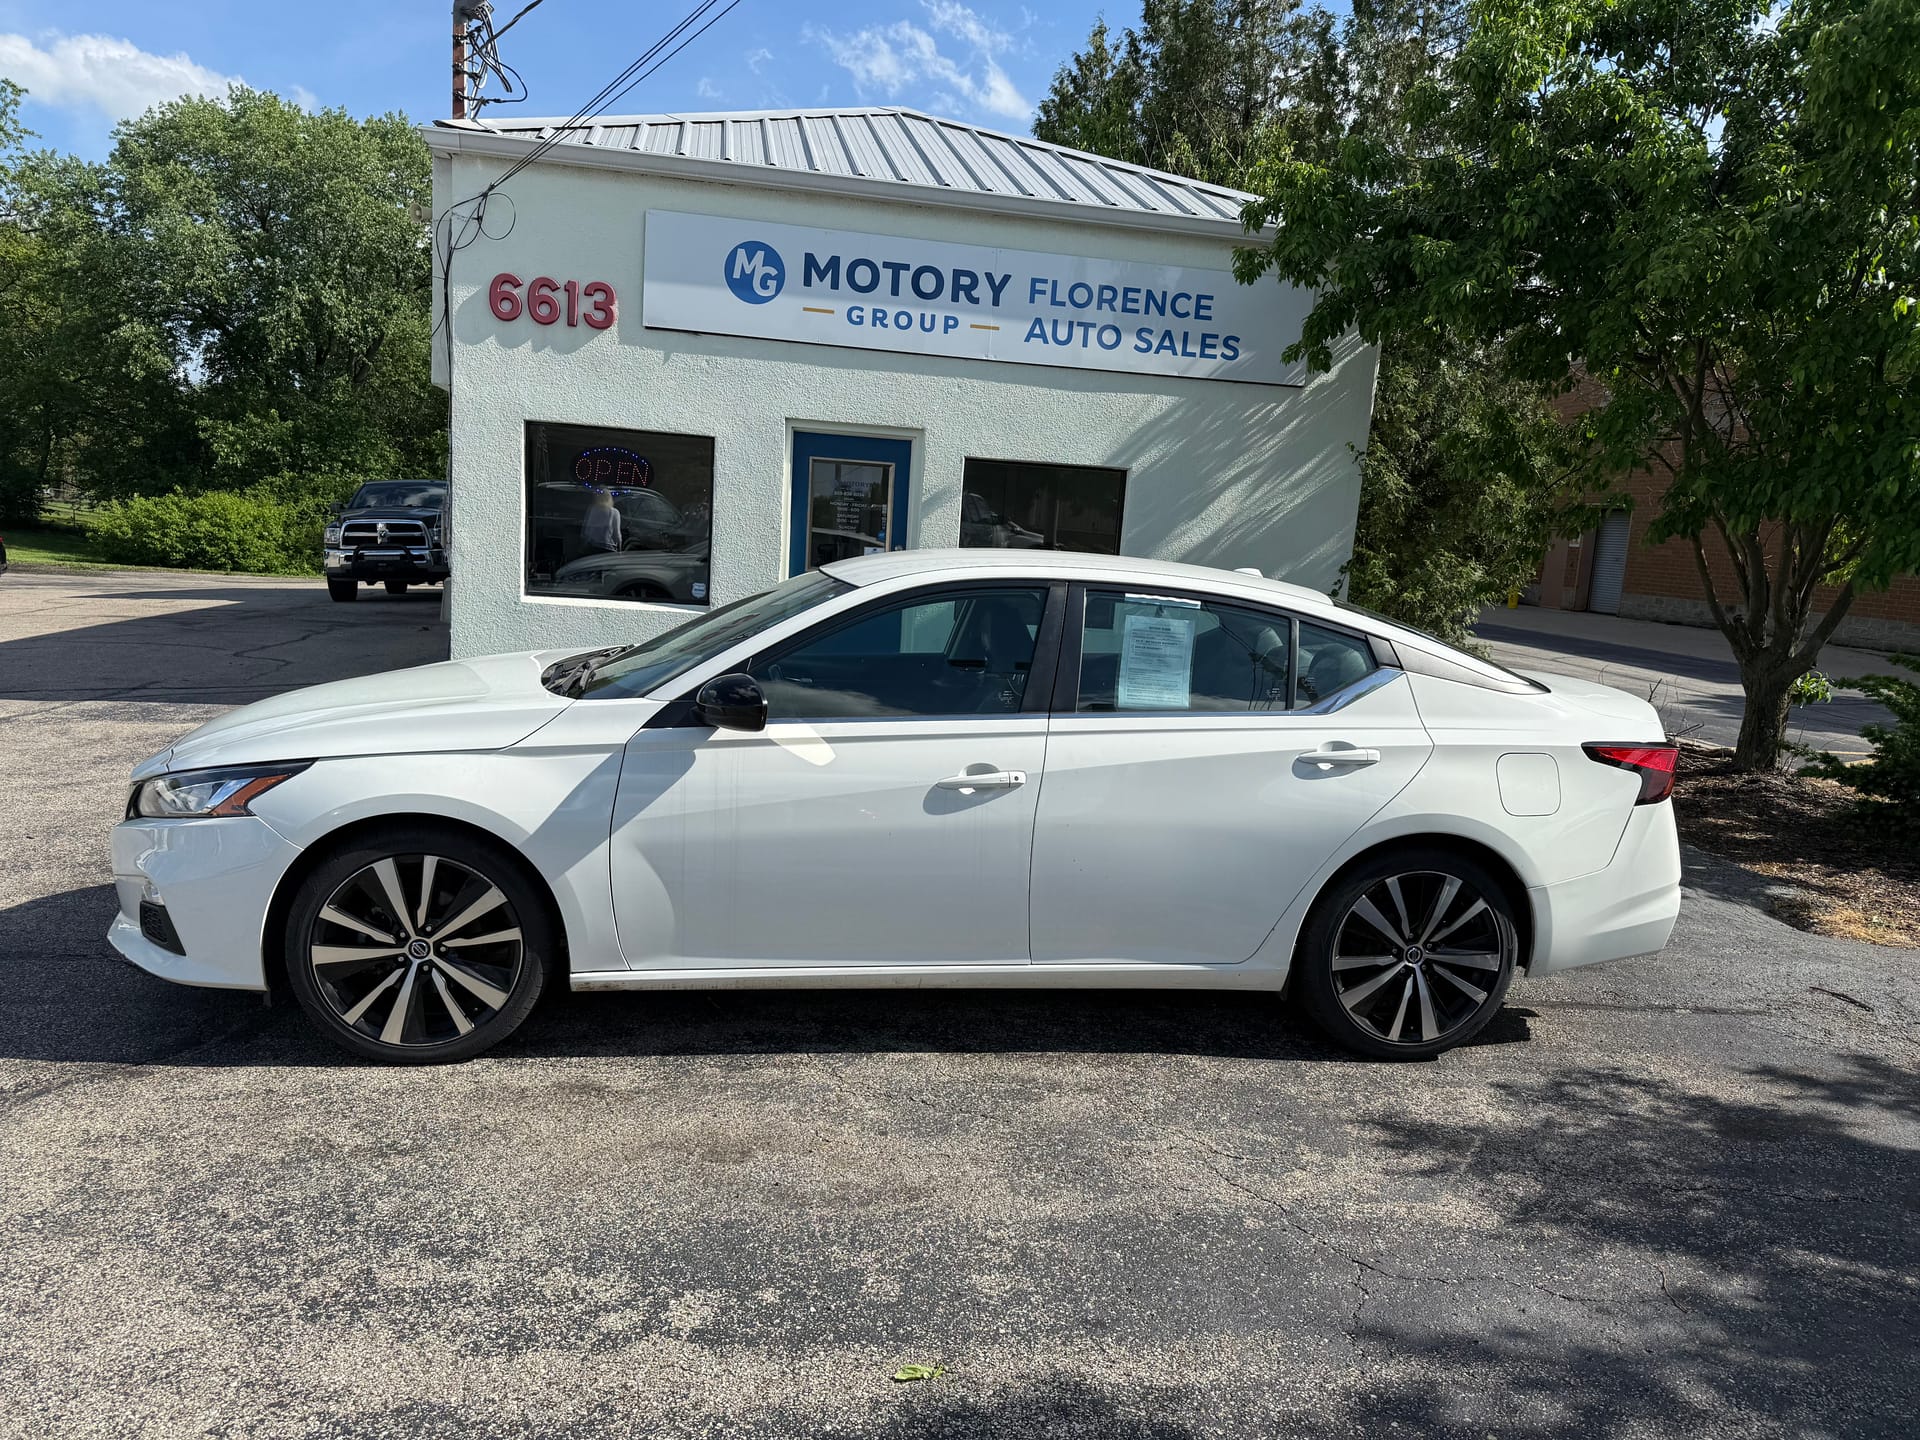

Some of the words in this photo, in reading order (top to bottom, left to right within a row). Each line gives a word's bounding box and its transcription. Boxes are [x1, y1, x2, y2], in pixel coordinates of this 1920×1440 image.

[732, 248, 778, 297] MG
[803, 252, 1012, 307] MOTORY
[488, 272, 617, 329] 6613
[846, 306, 960, 335] GROUP
[1029, 277, 1215, 321] FLORENCE
[1024, 317, 1123, 351] AUTO
[1133, 327, 1241, 361] SALES
[575, 457, 650, 487] OPEN
